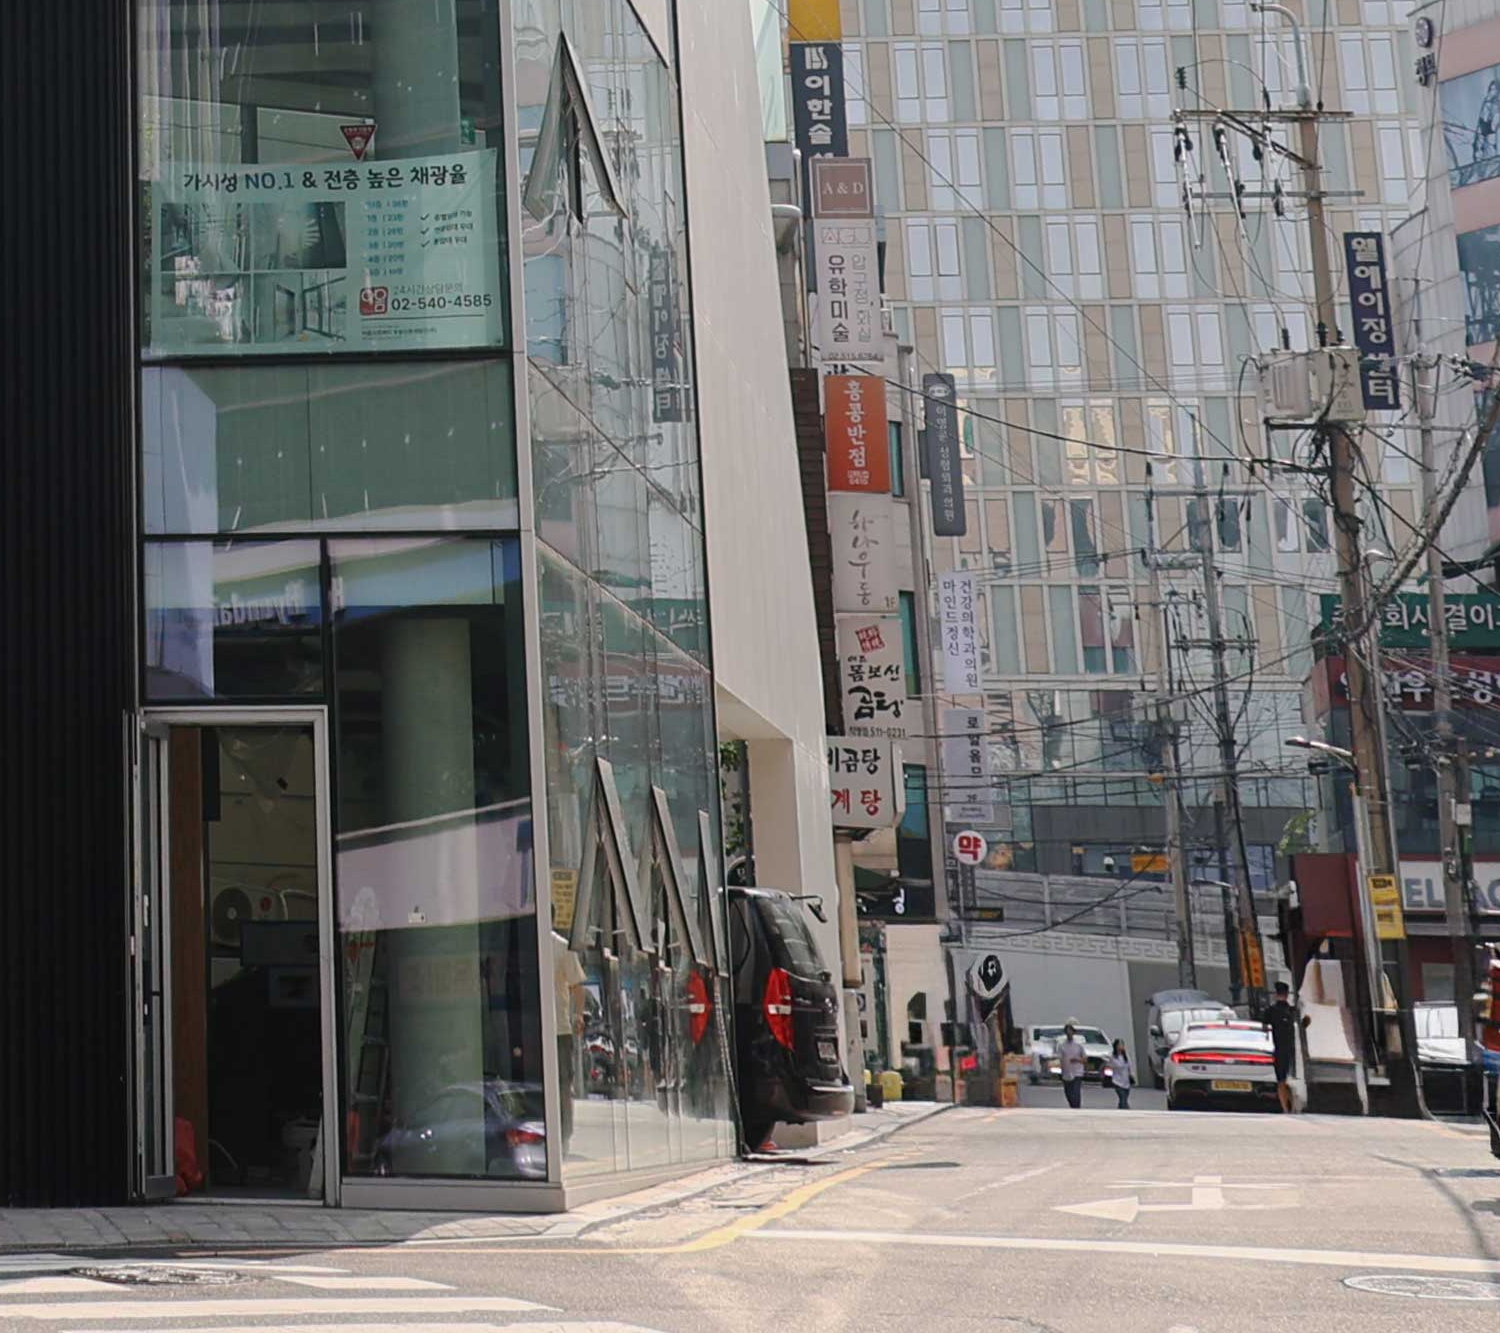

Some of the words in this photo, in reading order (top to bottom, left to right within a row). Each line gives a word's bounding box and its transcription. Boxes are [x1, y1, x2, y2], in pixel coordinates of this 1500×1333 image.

[184, 172, 238, 192] 가시성
[244, 172, 295, 192] NO.1
[302, 172, 317, 190] &
[324, 169, 360, 190] 전층
[366, 167, 402, 188] 높은
[410, 164, 467, 186] 채광율
[391, 294, 492, 311] 02-540-4585
[828, 253, 850, 343] 유학미술
[842, 380, 867, 469] 홍콩반점
[848, 685, 903, 720] 곰탕
[958, 835, 982, 862] 약
